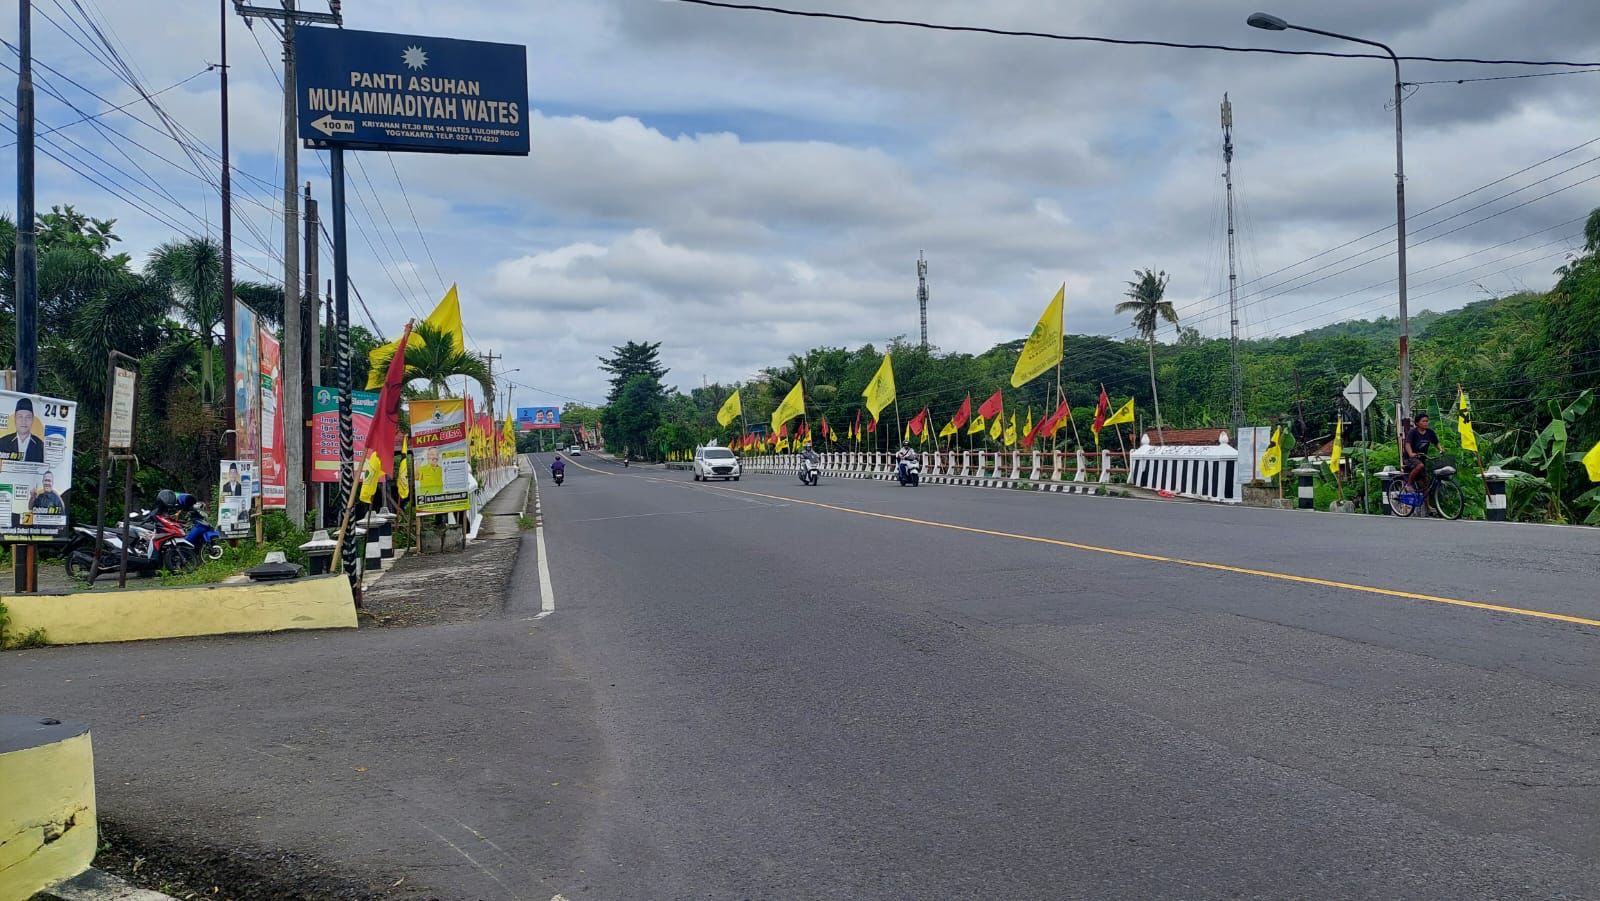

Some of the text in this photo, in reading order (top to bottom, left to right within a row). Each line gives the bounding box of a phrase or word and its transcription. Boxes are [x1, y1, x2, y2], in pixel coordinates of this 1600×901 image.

[351, 72, 480, 96] PANTI ASUHAN
[309, 88, 519, 124] MUHAMMADIYAH WATES
[323, 122, 341, 130] 100
[362, 121, 400, 129] KRIYANAN
[446, 126, 470, 134] WATES
[471, 127, 520, 137] KULONPROGO
[385, 129, 434, 139] YOGYAKARTA
[456, 133, 473, 141] 0274
[474, 135, 499, 143] 774230
[44, 404, 57, 417] 24
[416, 433, 438, 445] KITA
[418, 496, 425, 505] 2
